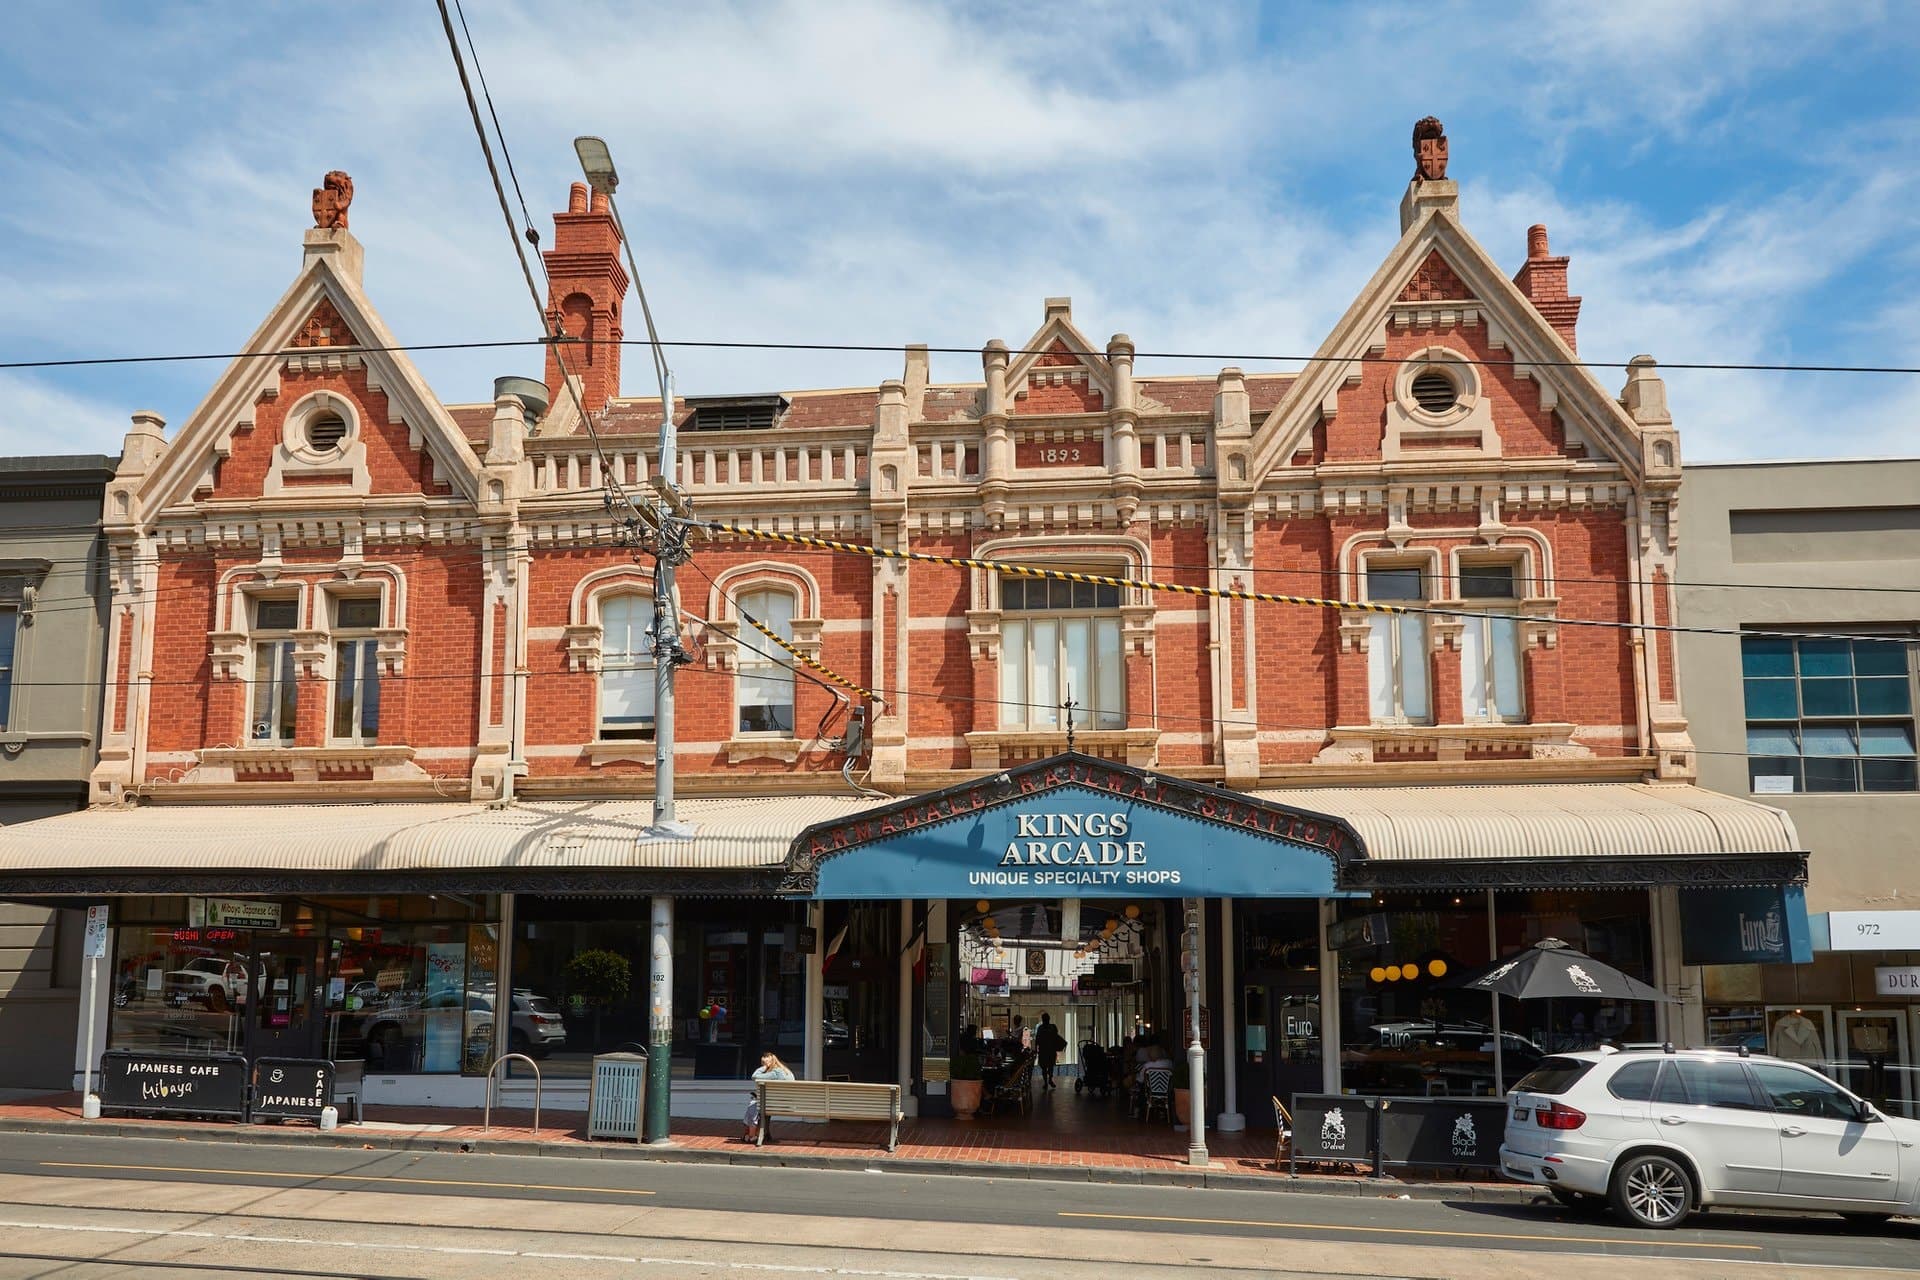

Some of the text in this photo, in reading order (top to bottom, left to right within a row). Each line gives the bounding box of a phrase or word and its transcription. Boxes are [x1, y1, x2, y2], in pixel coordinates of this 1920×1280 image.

[1040, 449, 1080, 463] 1893
[810, 763, 1346, 858] ARMADALE RAILWAY STATION
[1016, 813, 1129, 838] KINGS
[1000, 841, 1147, 866] ARCADE
[969, 870, 1181, 885] UNIQUE SPECIALTY SHOPS
[173, 929, 235, 941] SUSHI OPEN
[1739, 912, 1766, 952] Euro
[1857, 924, 1880, 936] 972
[653, 974, 665, 982] 102
[1888, 974, 1920, 988] DUR
[1287, 1016, 1312, 1036] Euro
[1380, 1027, 1411, 1048] Euro
[127, 1062, 219, 1076] JAPANESE CAFE
[142, 1078, 193, 1100] Mibaya
[315, 1069, 325, 1107] CAFE
[261, 1095, 322, 1108] JAPANESE
